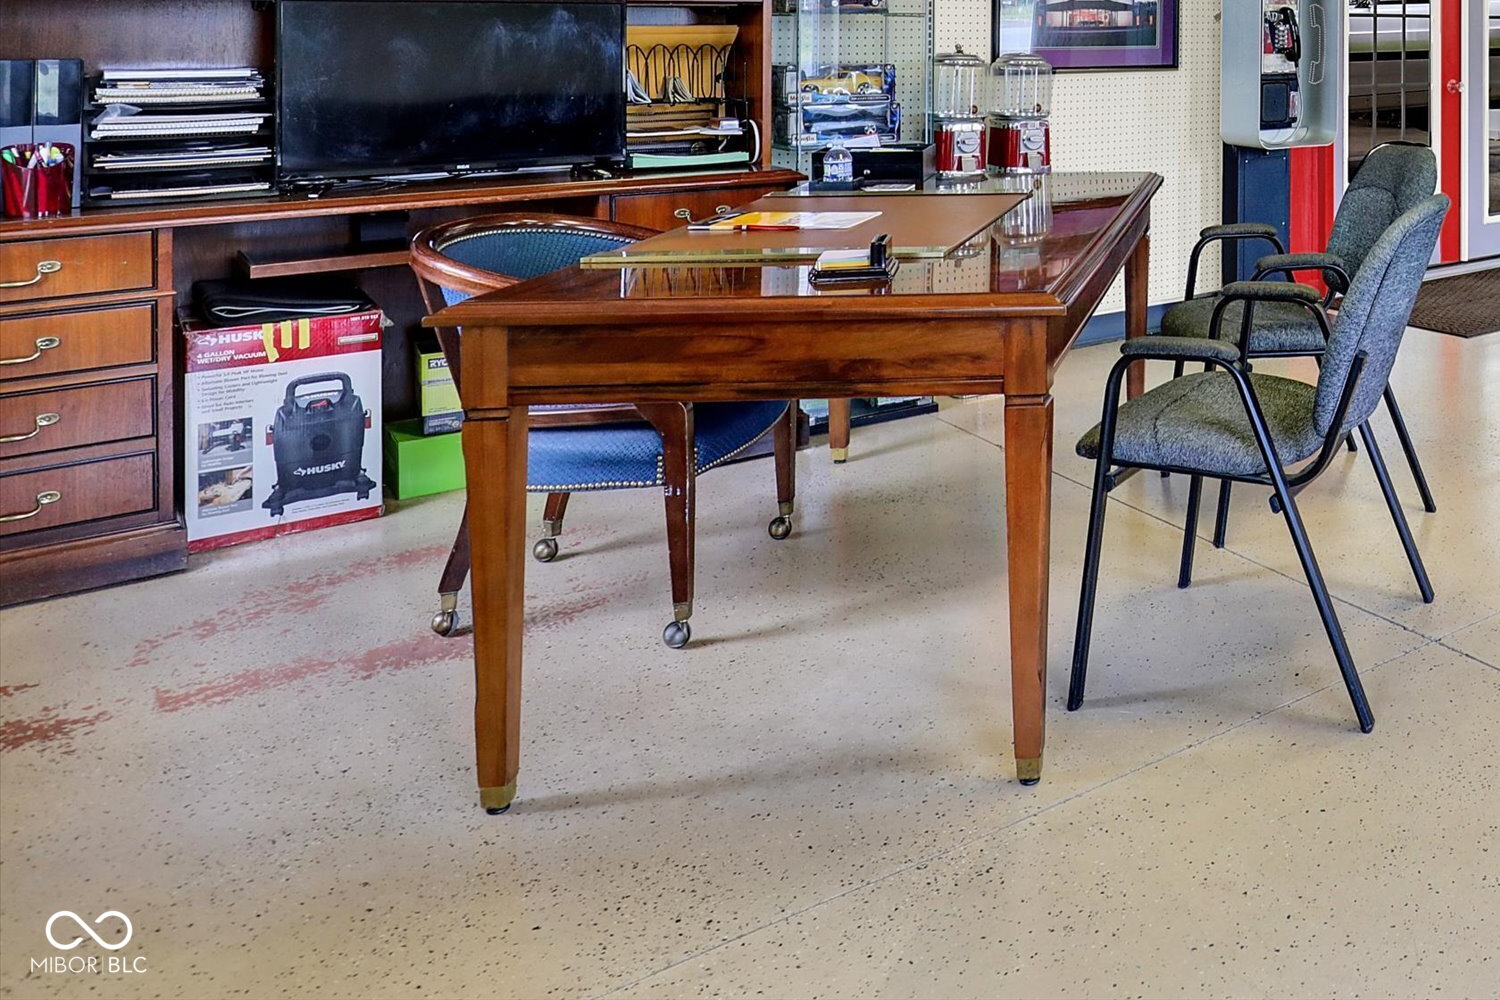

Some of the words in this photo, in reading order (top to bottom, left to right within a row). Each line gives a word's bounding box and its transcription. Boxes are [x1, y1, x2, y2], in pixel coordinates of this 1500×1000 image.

[217, 330, 264, 344] HUSK
[197, 355, 232, 365] WET/DRY
[233, 351, 267, 361] VACUUM
[205, 349, 235, 358] GALLON
[306, 459, 346, 475] HUSKY
